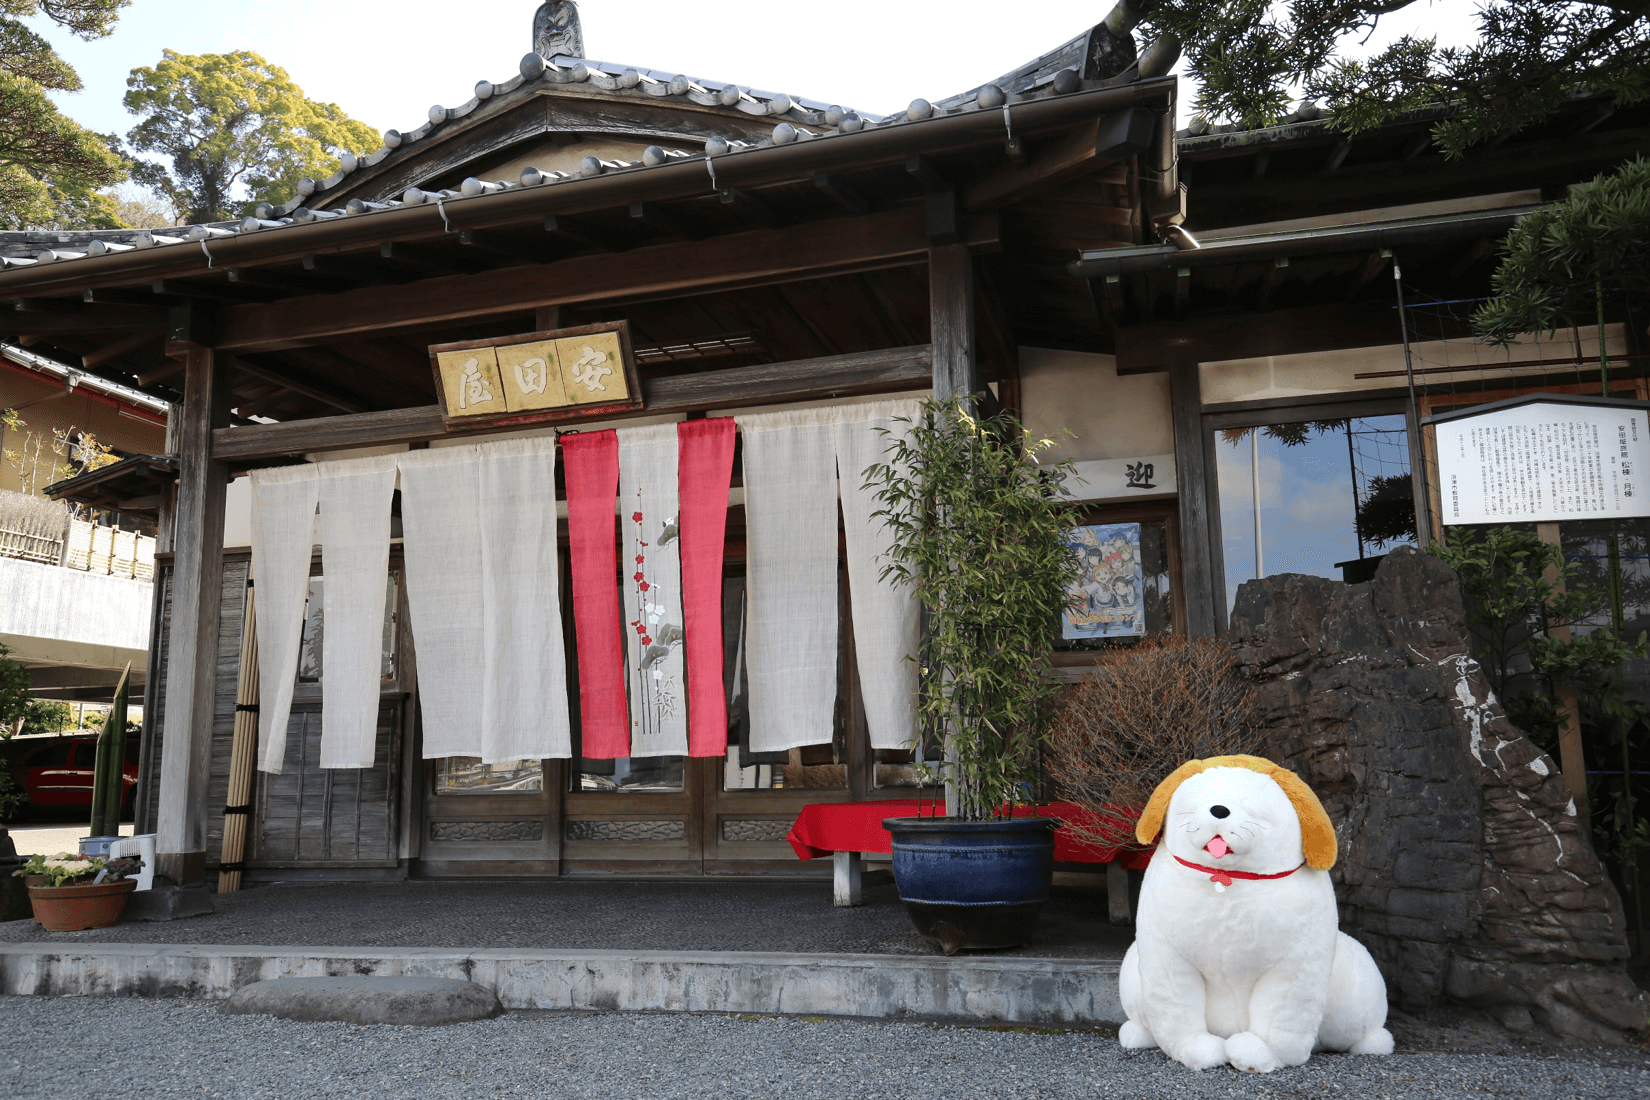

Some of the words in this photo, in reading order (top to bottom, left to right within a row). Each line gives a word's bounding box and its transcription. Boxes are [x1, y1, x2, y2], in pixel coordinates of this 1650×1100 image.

[459, 346, 613, 409] 安田屋
[1617, 425, 1629, 459] 安田屋旅館
